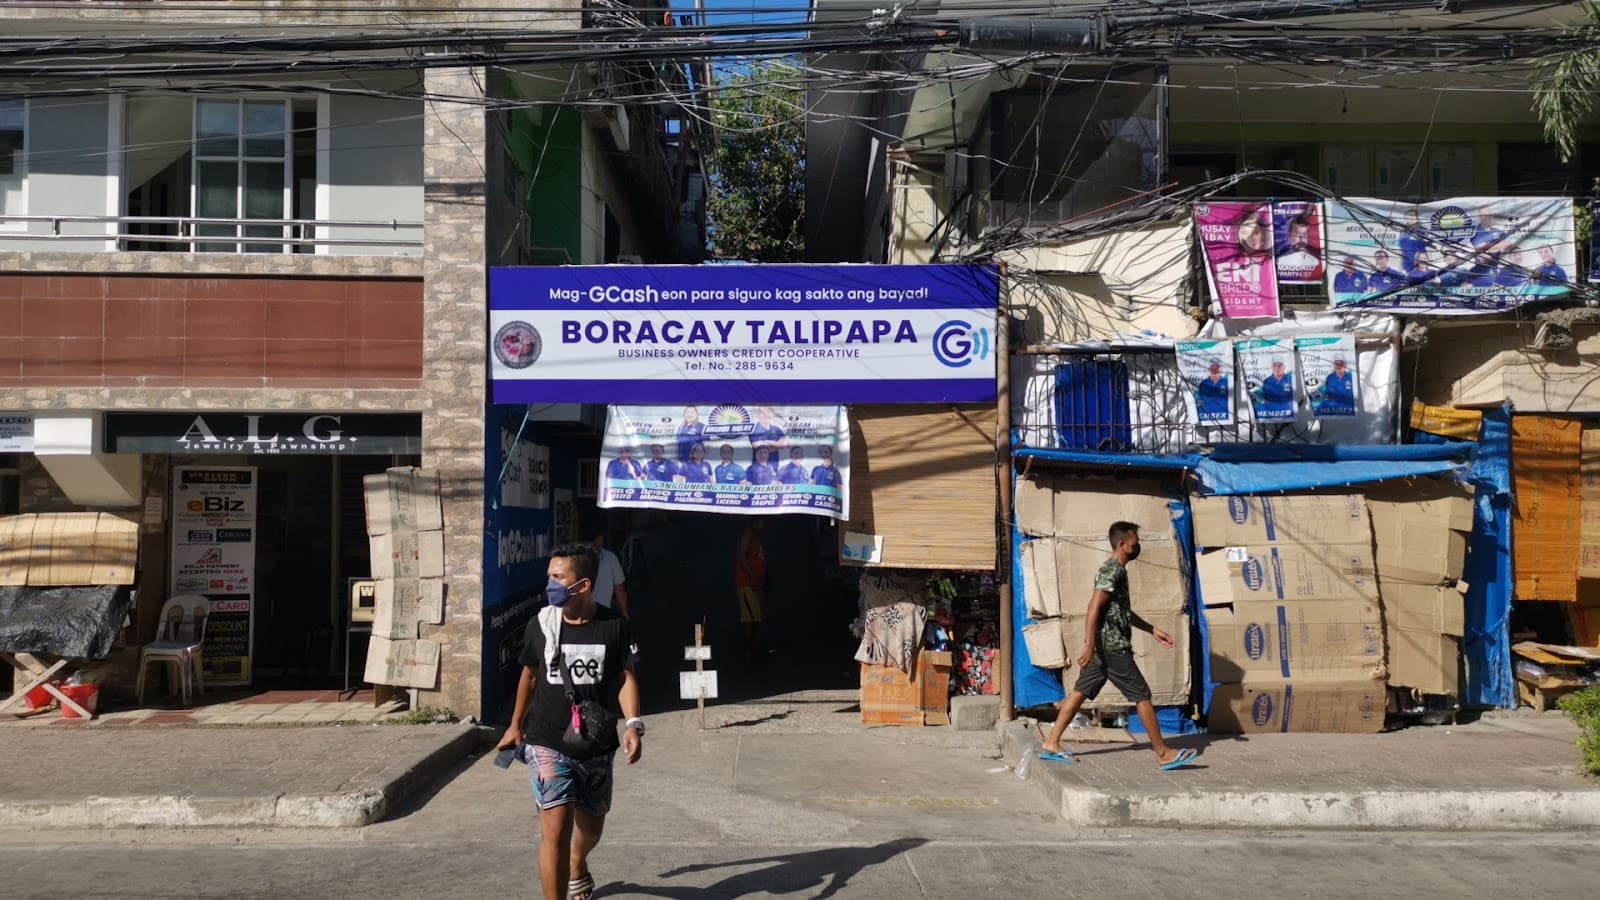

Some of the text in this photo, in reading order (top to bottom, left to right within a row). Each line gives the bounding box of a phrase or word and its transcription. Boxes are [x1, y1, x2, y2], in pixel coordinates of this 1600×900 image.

[1203, 233, 1231, 242] IBAY
[691, 290, 724, 304] para
[727, 287, 772, 304] siguro
[776, 286, 803, 304] kag
[805, 286, 845, 301] sakto
[848, 290, 876, 304] ang
[561, 320, 736, 345] BORACAY
[745, 320, 917, 345] TALIPAPA
[618, 349, 860, 358] BUSINESS OWNERS CREDIT COOPERATIVE
[684, 362, 712, 371] Tel.
[735, 362, 794, 371] 288-9634
[185, 442, 347, 451] Jewelry & Pawnshop
[187, 496, 245, 512] eBiz
